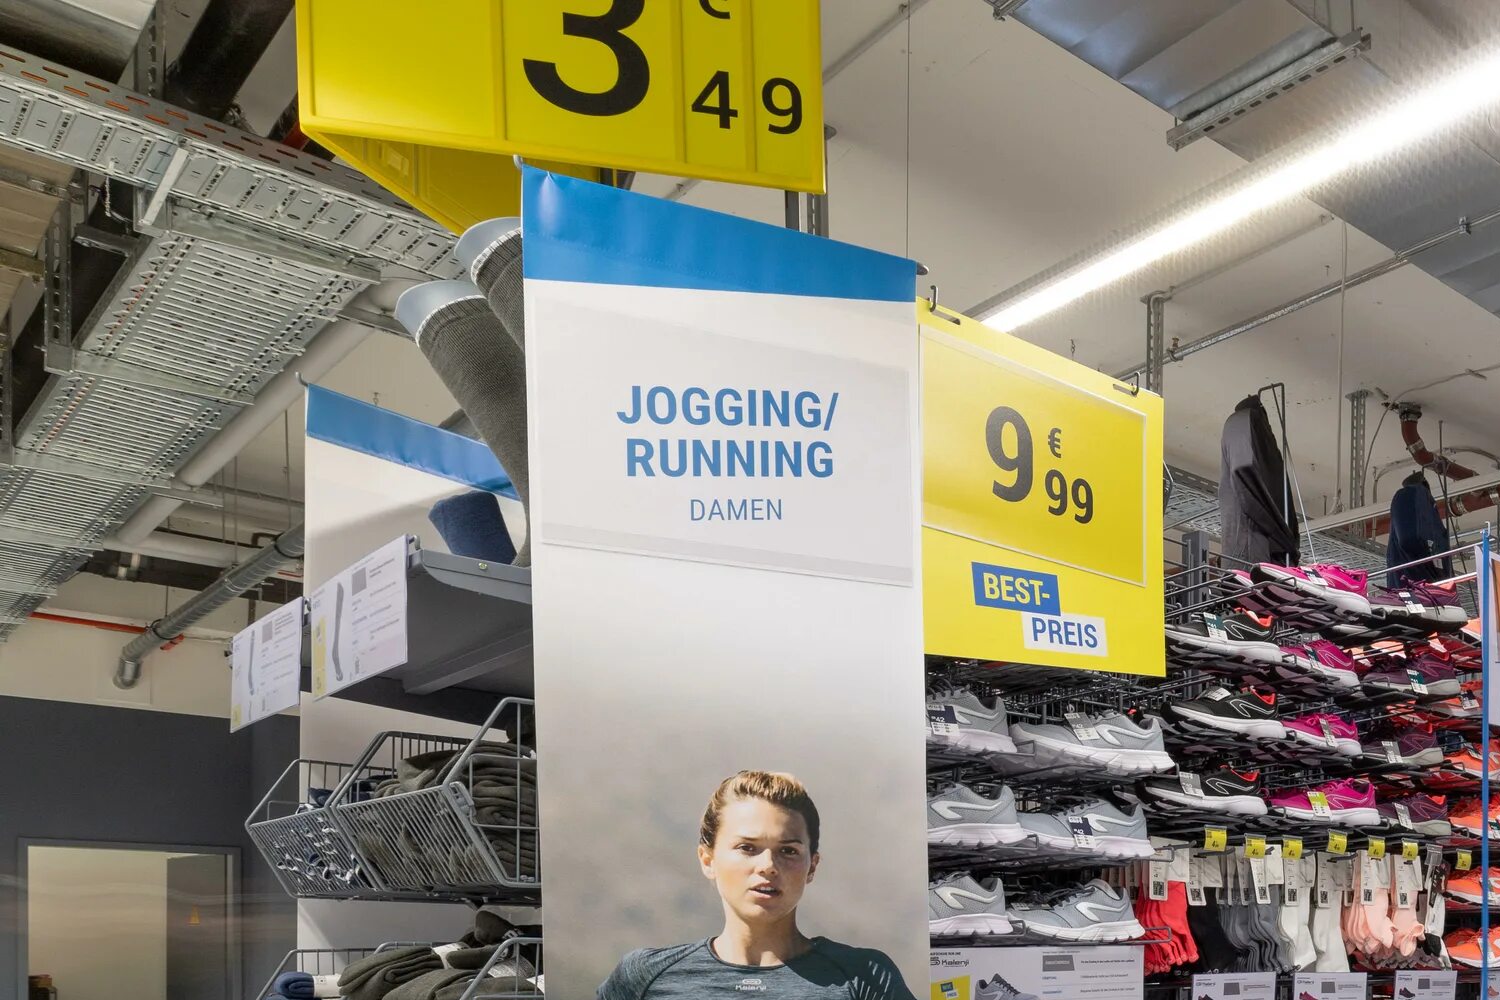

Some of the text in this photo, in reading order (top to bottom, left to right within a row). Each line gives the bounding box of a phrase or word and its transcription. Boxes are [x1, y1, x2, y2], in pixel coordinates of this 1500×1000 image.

[523, 0, 650, 117] 3
[616, 385, 839, 431] JOGGING/
[626, 438, 834, 478] RUNNING
[985, 405, 1094, 524] 9 € 99
[689, 498, 783, 521] DAMEN
[983, 571, 1050, 606] BEST-
[1031, 616, 1098, 649] PREIS
[941, 959, 970, 968] Kalenji
